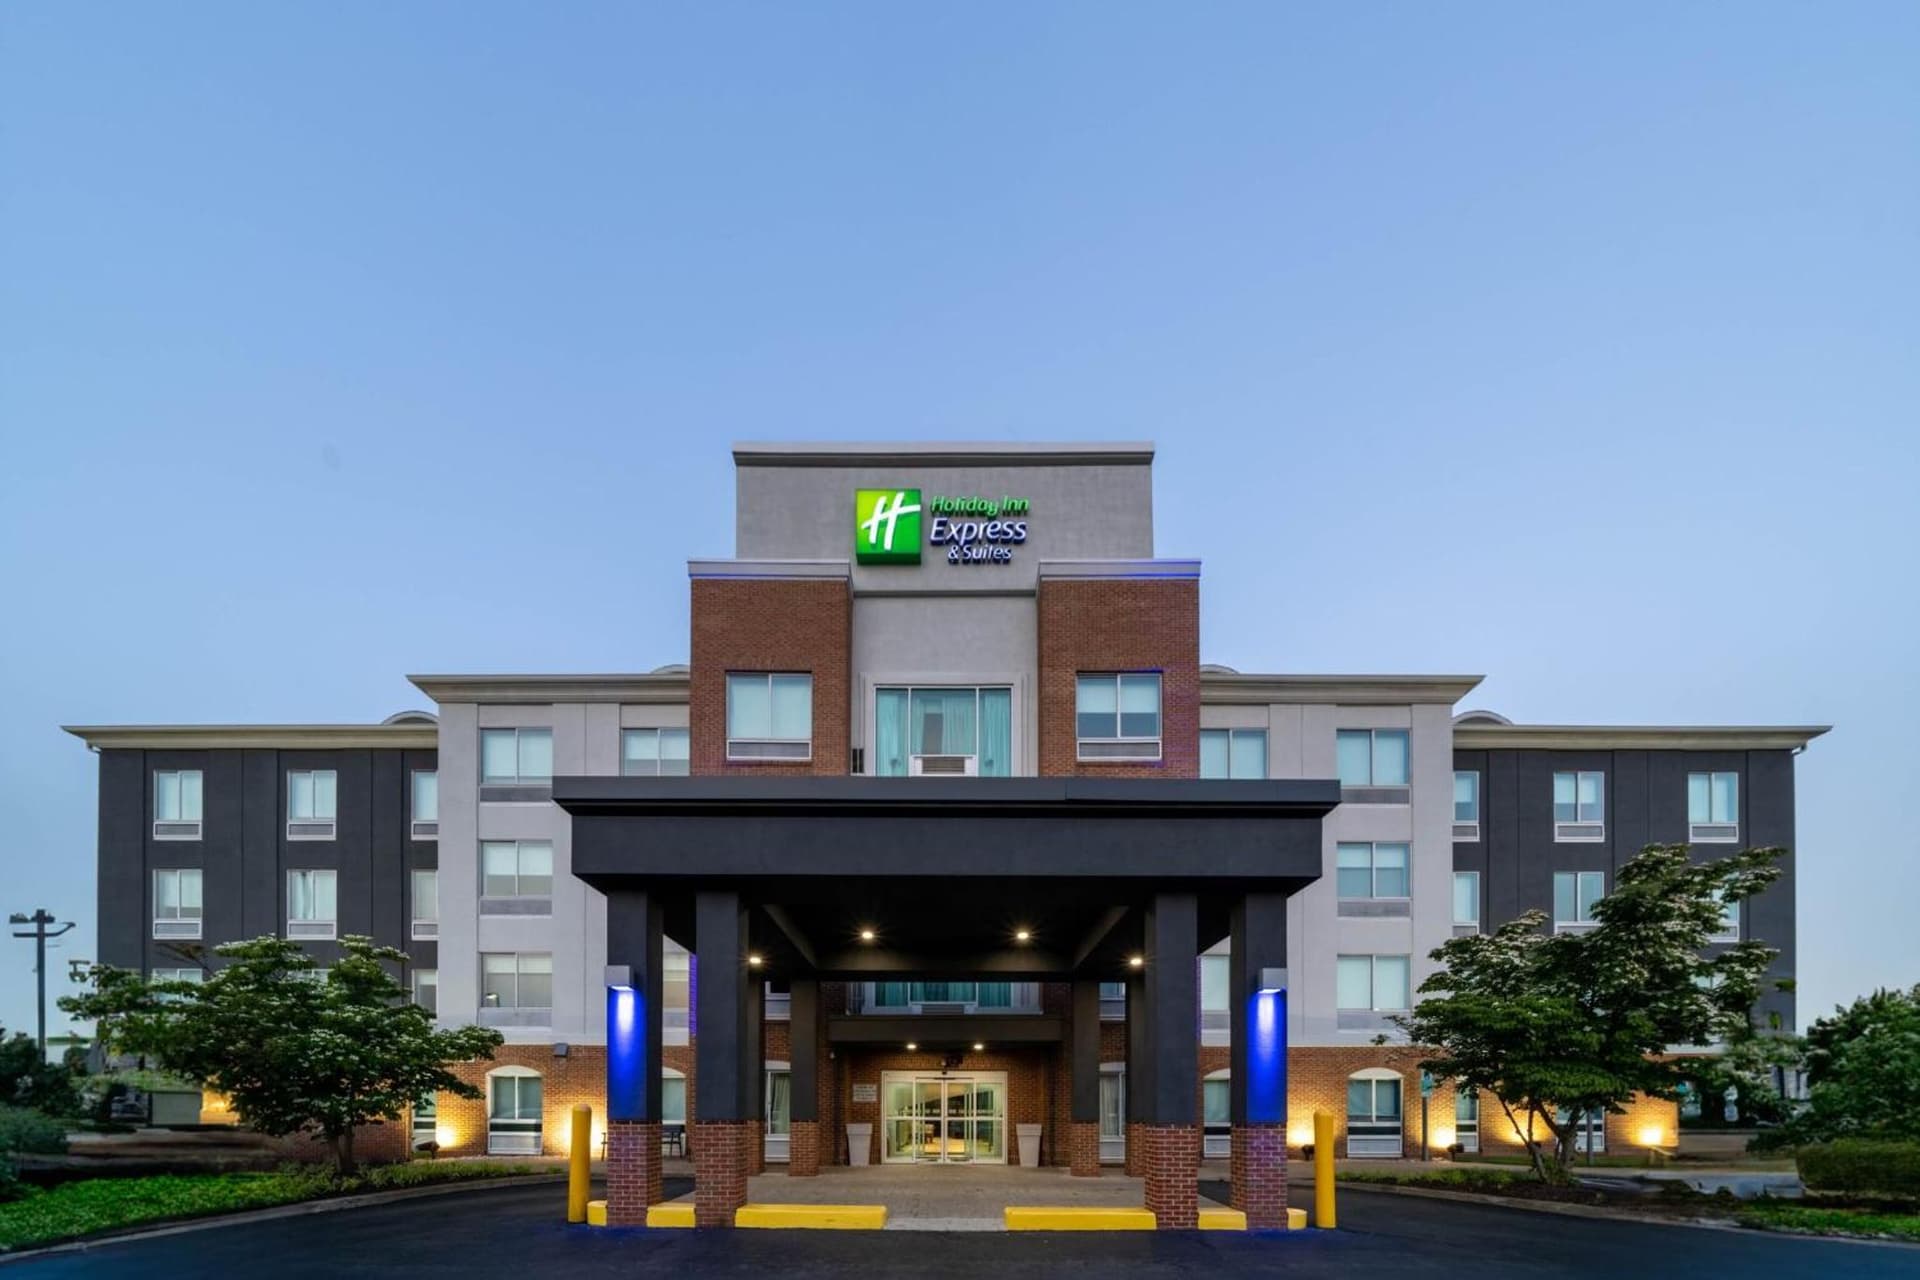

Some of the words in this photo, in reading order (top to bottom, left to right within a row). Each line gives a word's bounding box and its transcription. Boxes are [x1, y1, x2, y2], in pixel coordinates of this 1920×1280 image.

[931, 495, 999, 516] Holiday
[1002, 495, 1030, 512] Inn
[930, 517, 1027, 546] Express
[948, 544, 960, 560] &
[962, 544, 1012, 560] Suites
